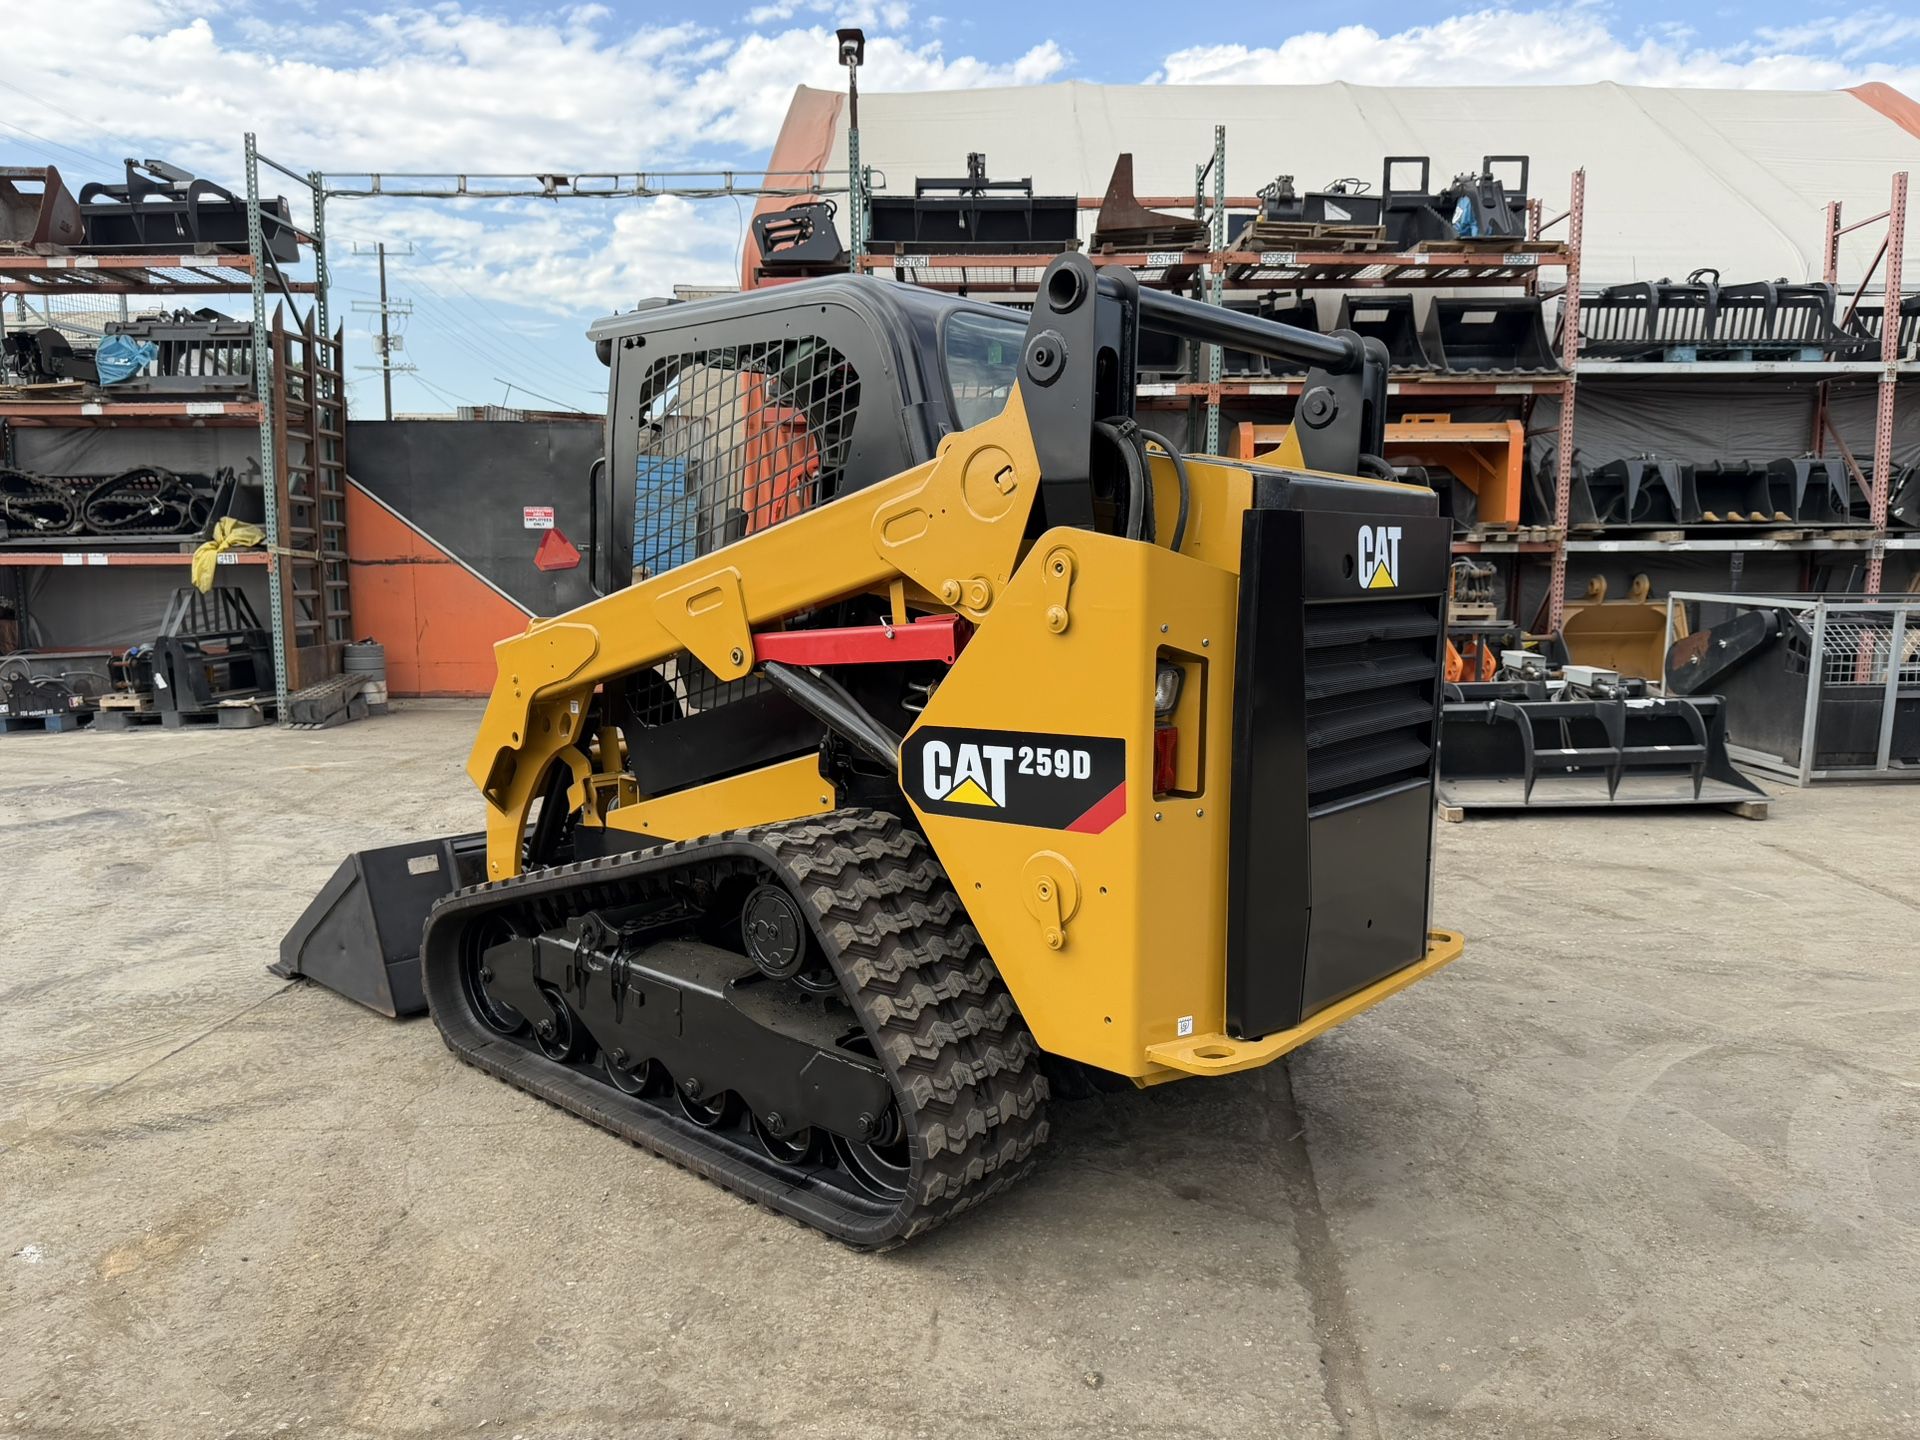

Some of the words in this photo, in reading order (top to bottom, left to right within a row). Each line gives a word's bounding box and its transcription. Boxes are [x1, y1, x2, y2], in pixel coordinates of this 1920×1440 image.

[1358, 525, 1402, 589] CAT
[923, 740, 1014, 808] CAT
[1018, 746, 1091, 780] 259D
